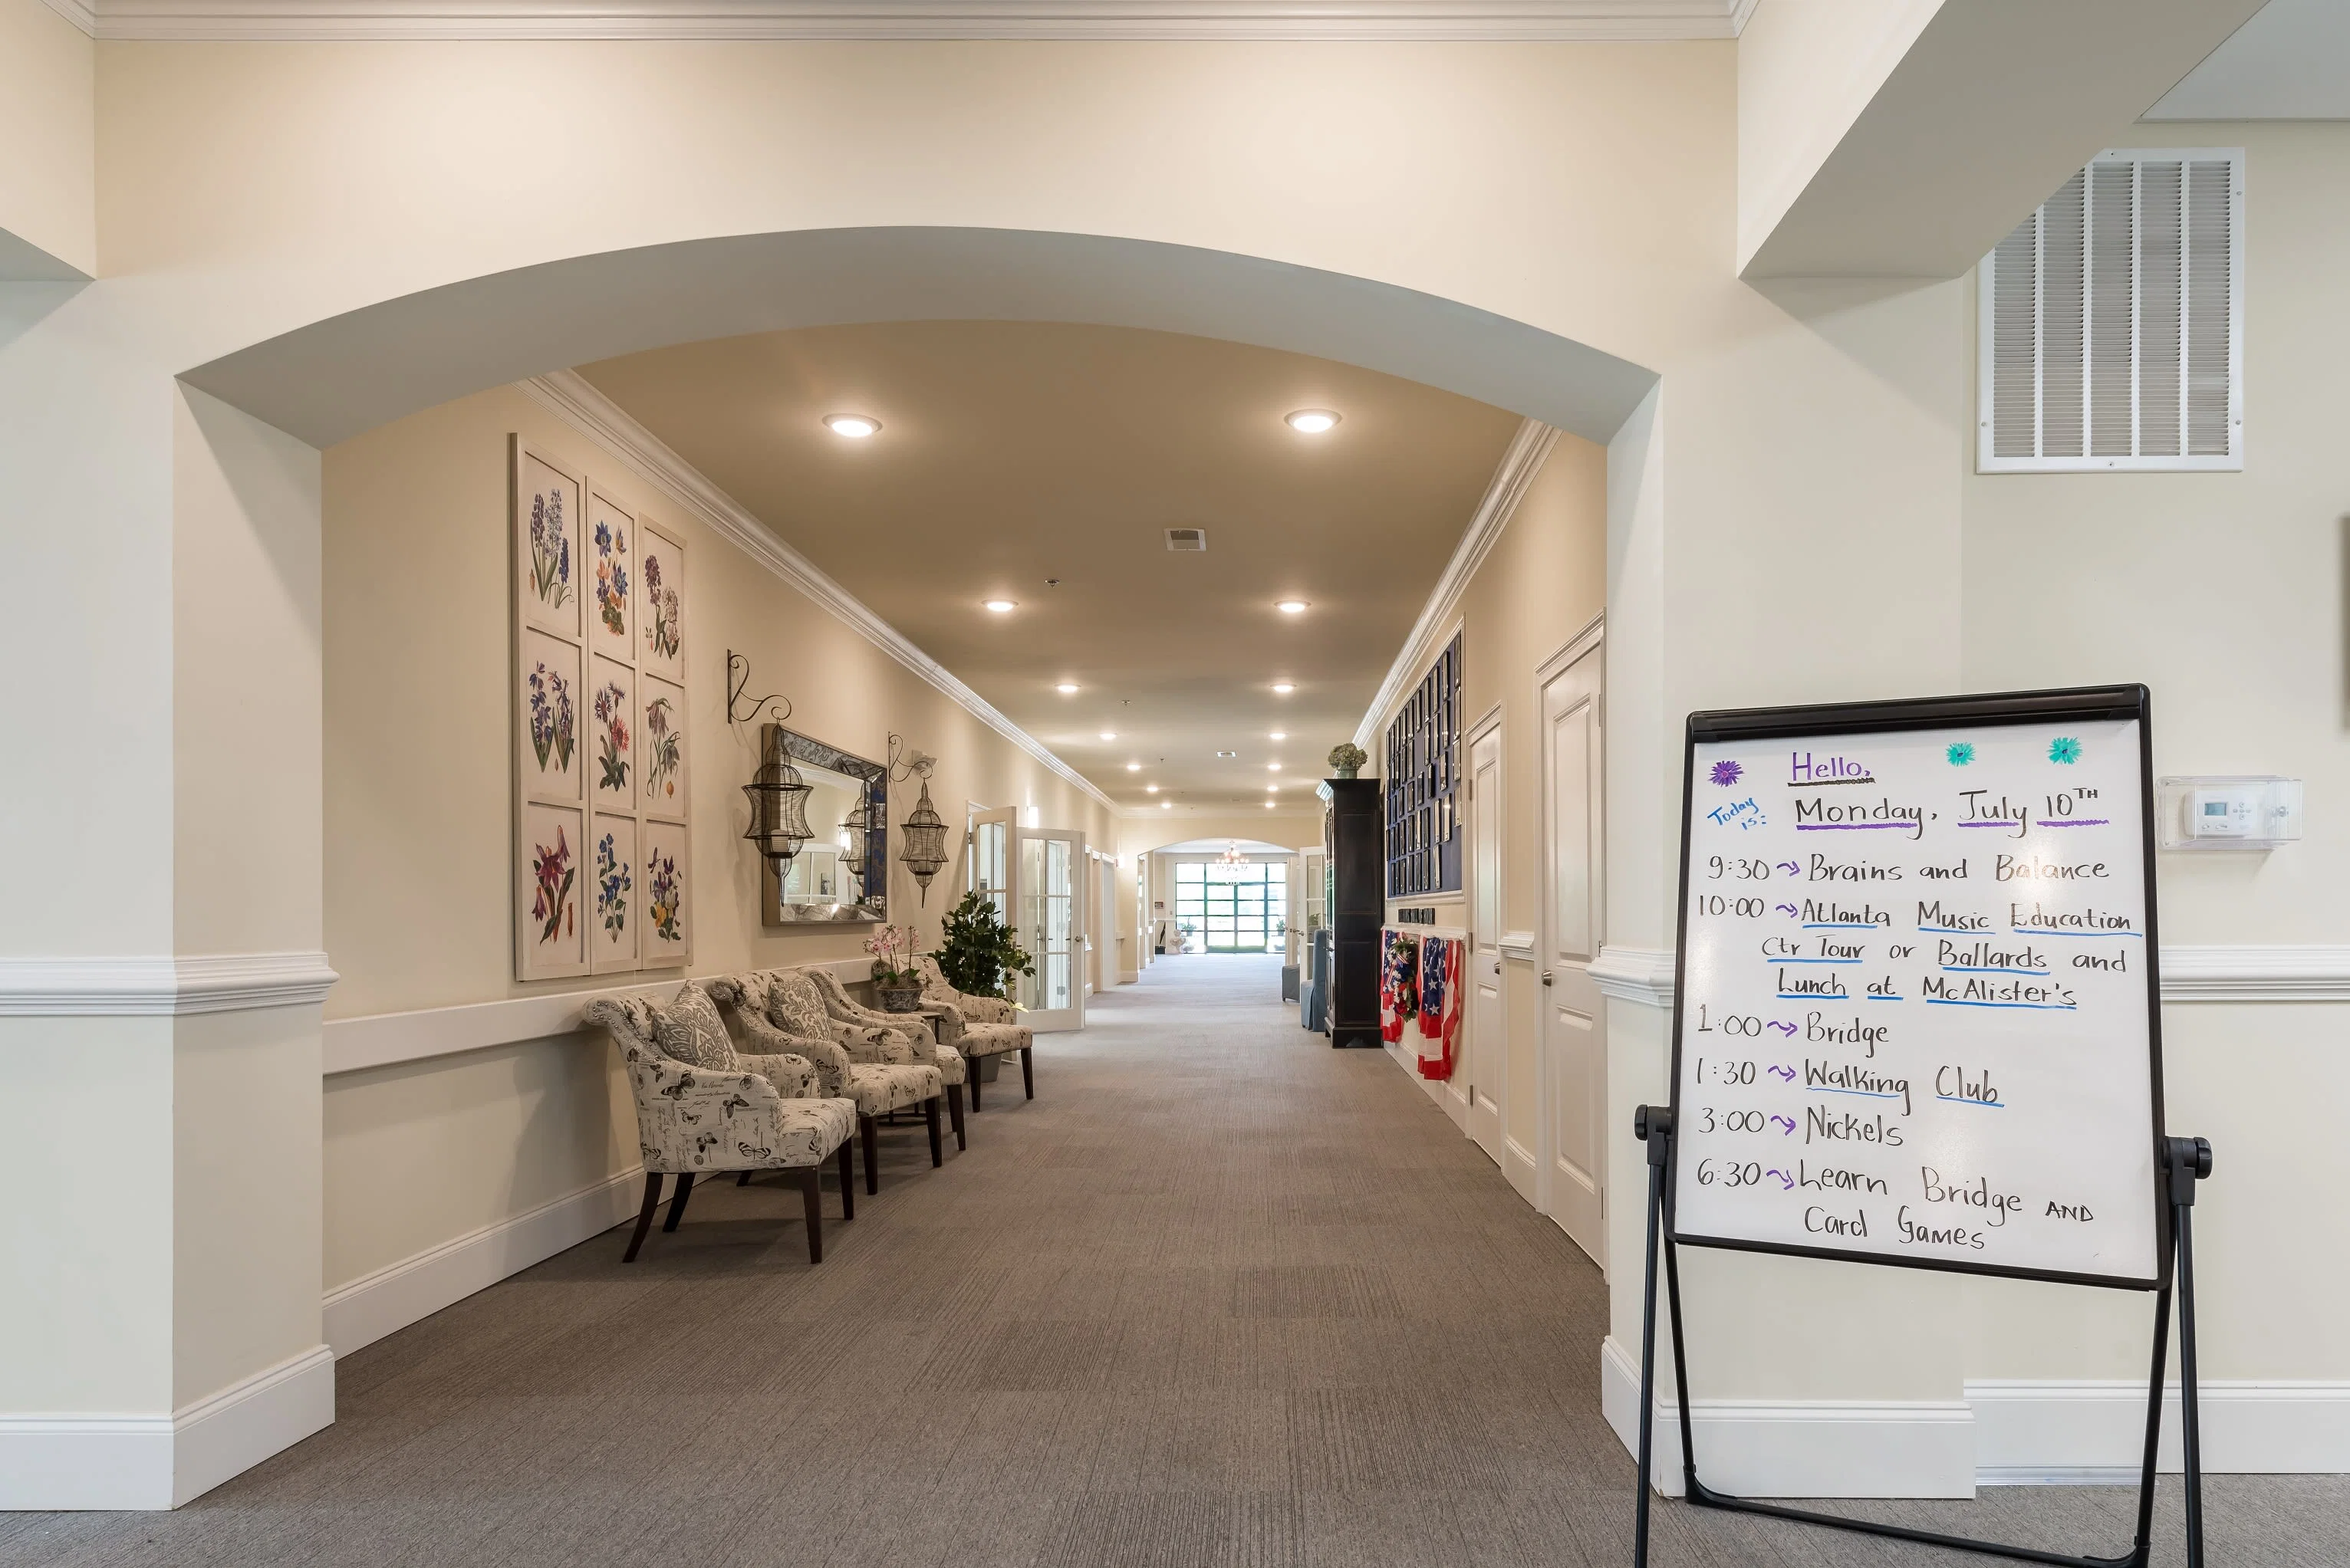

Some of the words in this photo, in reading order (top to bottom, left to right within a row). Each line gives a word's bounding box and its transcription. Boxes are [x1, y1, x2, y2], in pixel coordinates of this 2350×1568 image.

[1792, 751, 1871, 781] Hello,
[1707, 797, 1759, 827] Today
[1741, 815, 1767, 831] is:
[1795, 797, 1937, 840] Monday,
[1957, 789, 2028, 839] July
[1707, 856, 1770, 880] 9:30
[1808, 853, 1903, 883] Brains
[1919, 858, 1968, 879] and
[1995, 854, 2110, 882] Balance
[1700, 895, 1765, 919] 10:00
[1801, 899, 1891, 926] Atlanta
[1917, 900, 1990, 930] Music
[2010, 902, 2131, 931] Education
[1761, 937, 1801, 956] Ctr
[1815, 934, 1866, 958] Tour
[1889, 945, 1917, 959] or
[1937, 939, 2047, 968] Ballards
[2072, 950, 2126, 973] and
[1776, 971, 1848, 997] Lunch
[1866, 977, 1896, 995] at
[1921, 976, 2077, 1006] McAlister's
[1697, 1004, 1762, 1037] 1:00
[1806, 1011, 1890, 1059] Bridge
[1697, 1059, 1756, 1085] 1:30
[1805, 1058, 1911, 1116] Walking
[1935, 1065, 1998, 1104] Club
[1698, 1107, 1765, 1133] 3:00
[1805, 1106, 1904, 1147] Nickels
[1697, 1158, 1762, 1188] 6:30
[1799, 1159, 1888, 1195] Learn
[1921, 1165, 2023, 1227] Bridge
[2045, 1200, 2094, 1222] AND
[1804, 1206, 1868, 1238] Card
[1897, 1205, 1987, 1250] Games
